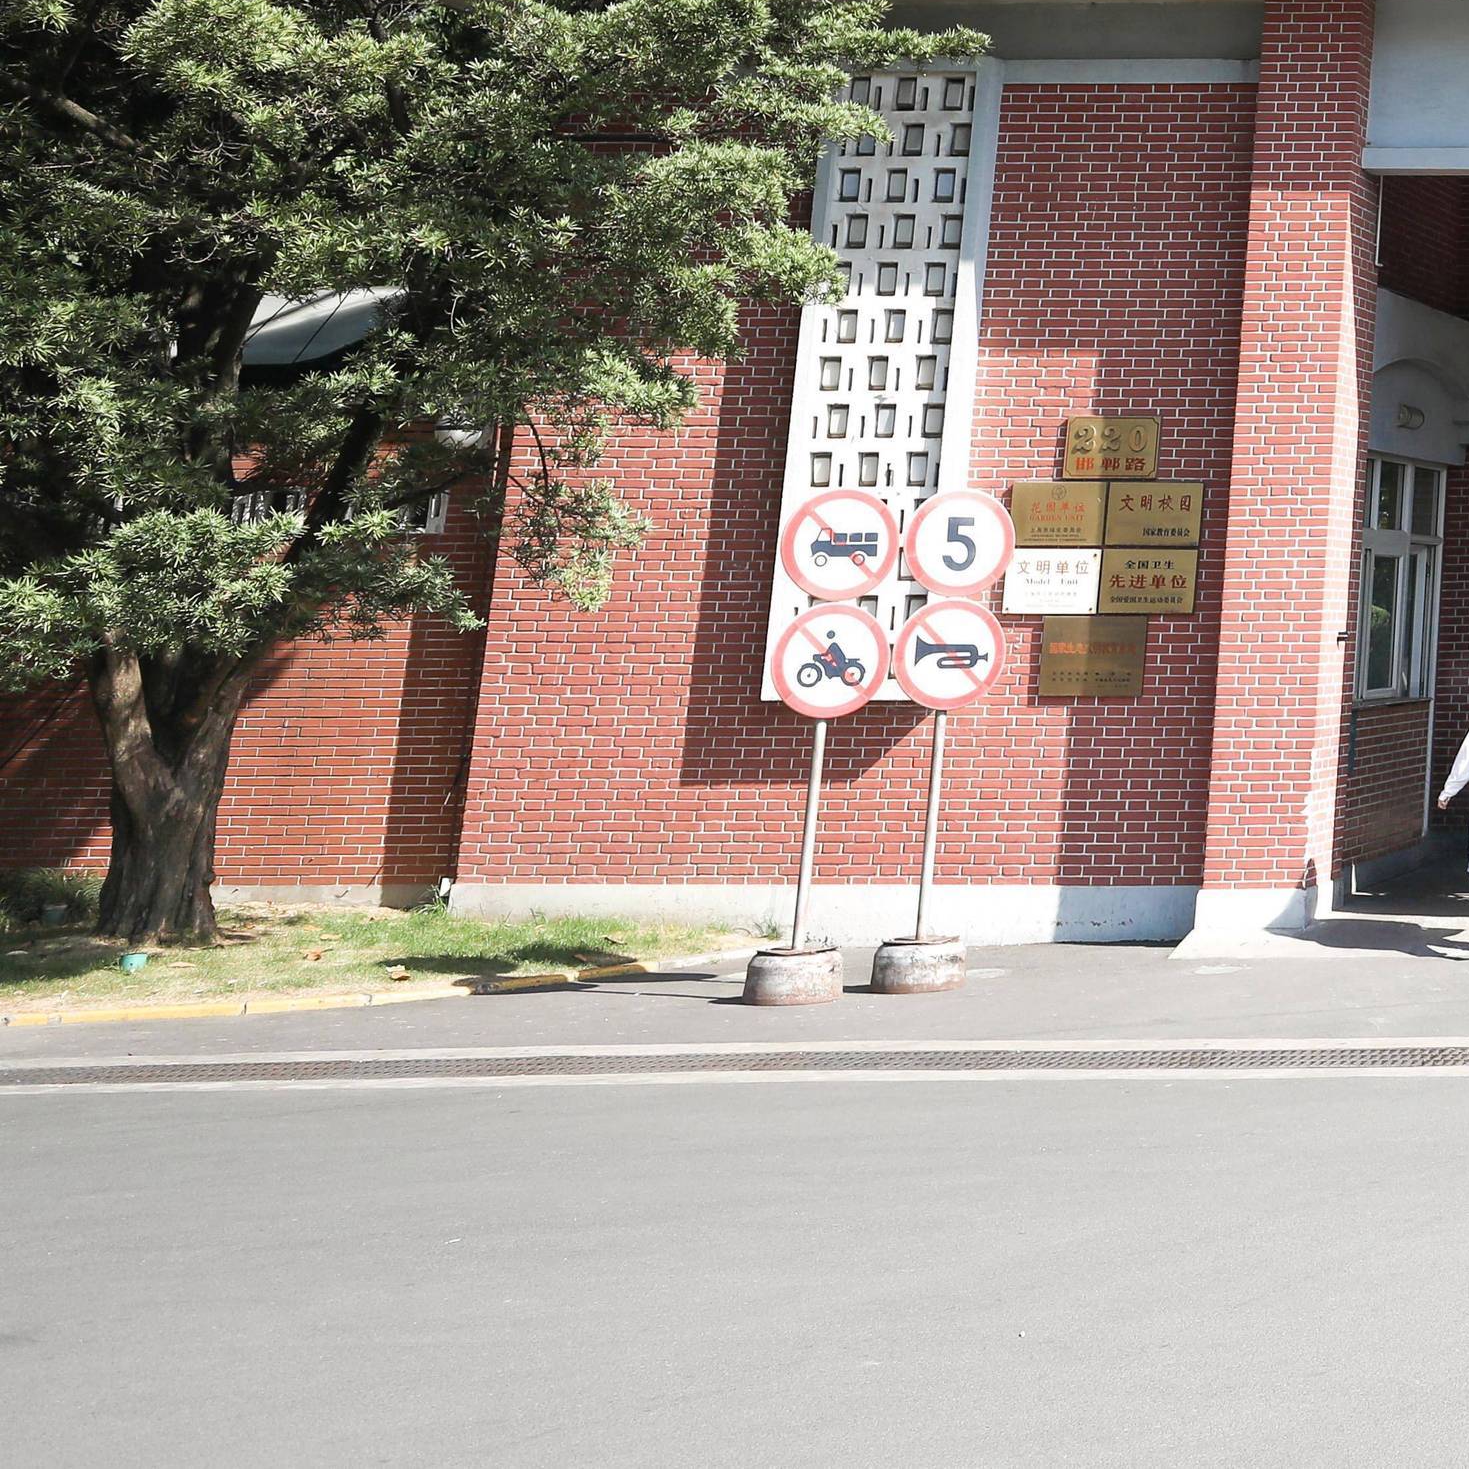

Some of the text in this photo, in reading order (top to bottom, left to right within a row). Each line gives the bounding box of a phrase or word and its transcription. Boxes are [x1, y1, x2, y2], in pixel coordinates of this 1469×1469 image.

[1071, 426, 1148, 453] 220
[1075, 457, 1146, 471] 邯郸路
[1118, 493, 1192, 512] 文明校园
[1065, 514, 1083, 522] UNIT
[942, 517, 976, 571] 5
[1017, 560, 1089, 575] 文明单位
[1124, 560, 1175, 570] 全国卫生
[1026, 578, 1079, 586] Model Unit
[1109, 574, 1188, 590] 先进单位
